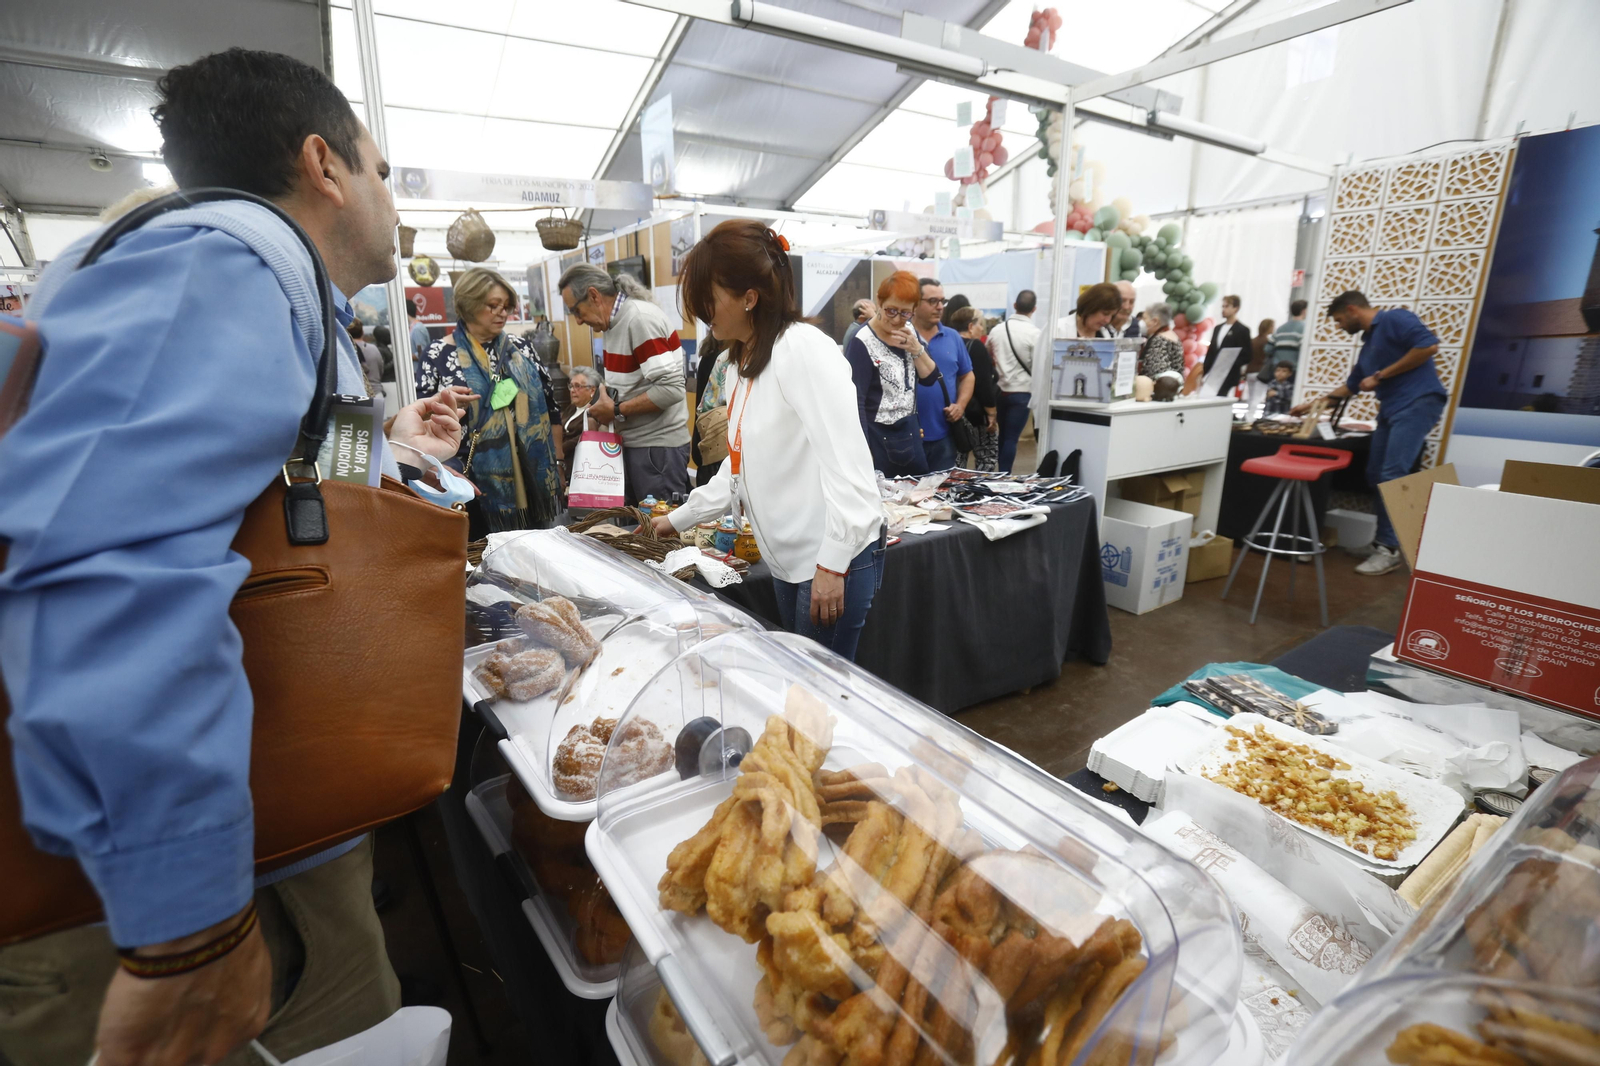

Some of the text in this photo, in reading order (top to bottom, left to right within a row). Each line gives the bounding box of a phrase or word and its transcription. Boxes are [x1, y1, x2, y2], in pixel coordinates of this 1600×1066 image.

[481, 176, 595, 191] FERIA DE LOS MUNICIPIOS 2022
[521, 190, 561, 204] ADAMUZ
[929, 224, 958, 235] BUJALANCE
[806, 261, 834, 269] CASTILLO
[335, 423, 354, 477] TRADICIÓN
[353, 429, 369, 473] SABOR A
[1454, 592, 1600, 633] SEÑORÍO DE LOS PEDROCHES
[1484, 608, 1582, 638] Calle Pozoblanco, 70
[1464, 611, 1485, 624] Telfs.
[1486, 616, 1504, 626] 957
[1505, 621, 1518, 630] 121
[1519, 625, 1536, 634] 167
[1541, 630, 1559, 641] 601
[1560, 635, 1580, 646] 625
[1581, 641, 1600, 651] 256
[1461, 626, 1488, 639] 14440
[1536, 646, 1550, 655] de
[1551, 650, 1596, 667] Córdoba
[1536, 654, 1568, 668] SPAIN
